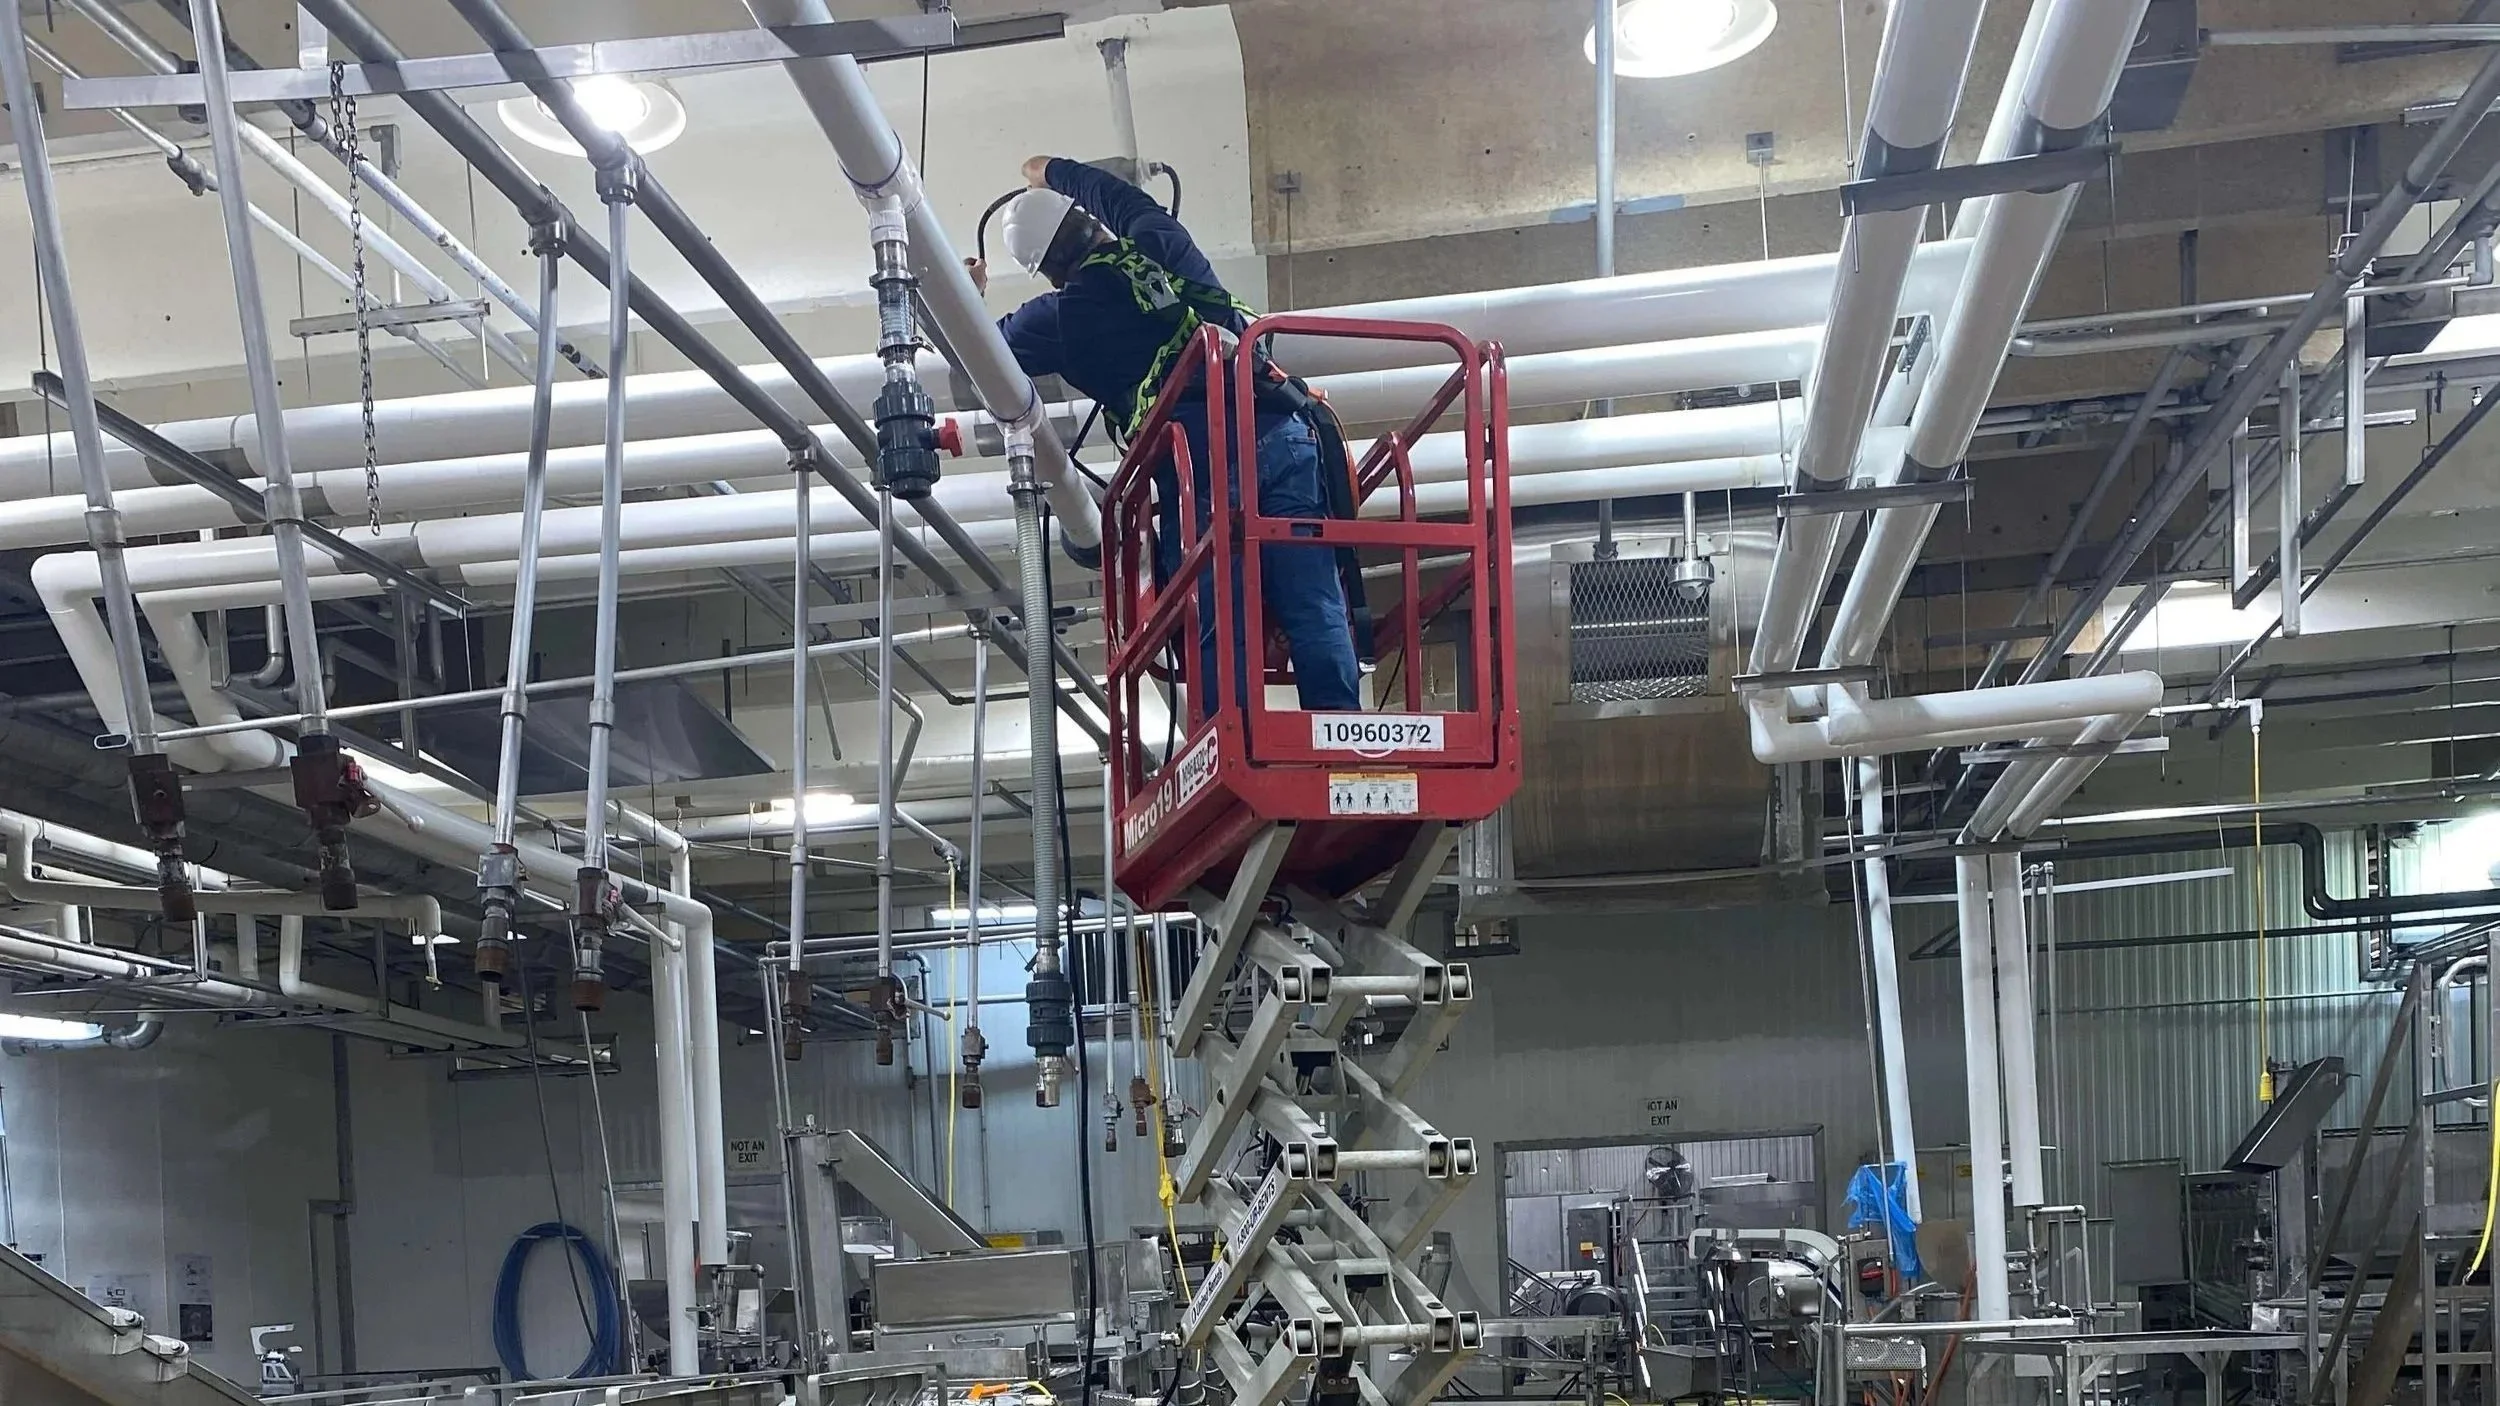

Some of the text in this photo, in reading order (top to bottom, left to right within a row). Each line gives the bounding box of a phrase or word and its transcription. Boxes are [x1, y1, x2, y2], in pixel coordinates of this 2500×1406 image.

[1323, 723, 1431, 744] 10960372
[1665, 1099, 1678, 1110] AN
[1651, 1115, 1671, 1126] EXIT
[731, 1140, 765, 1152] NOT AN
[738, 1152, 758, 1163] EXIT
